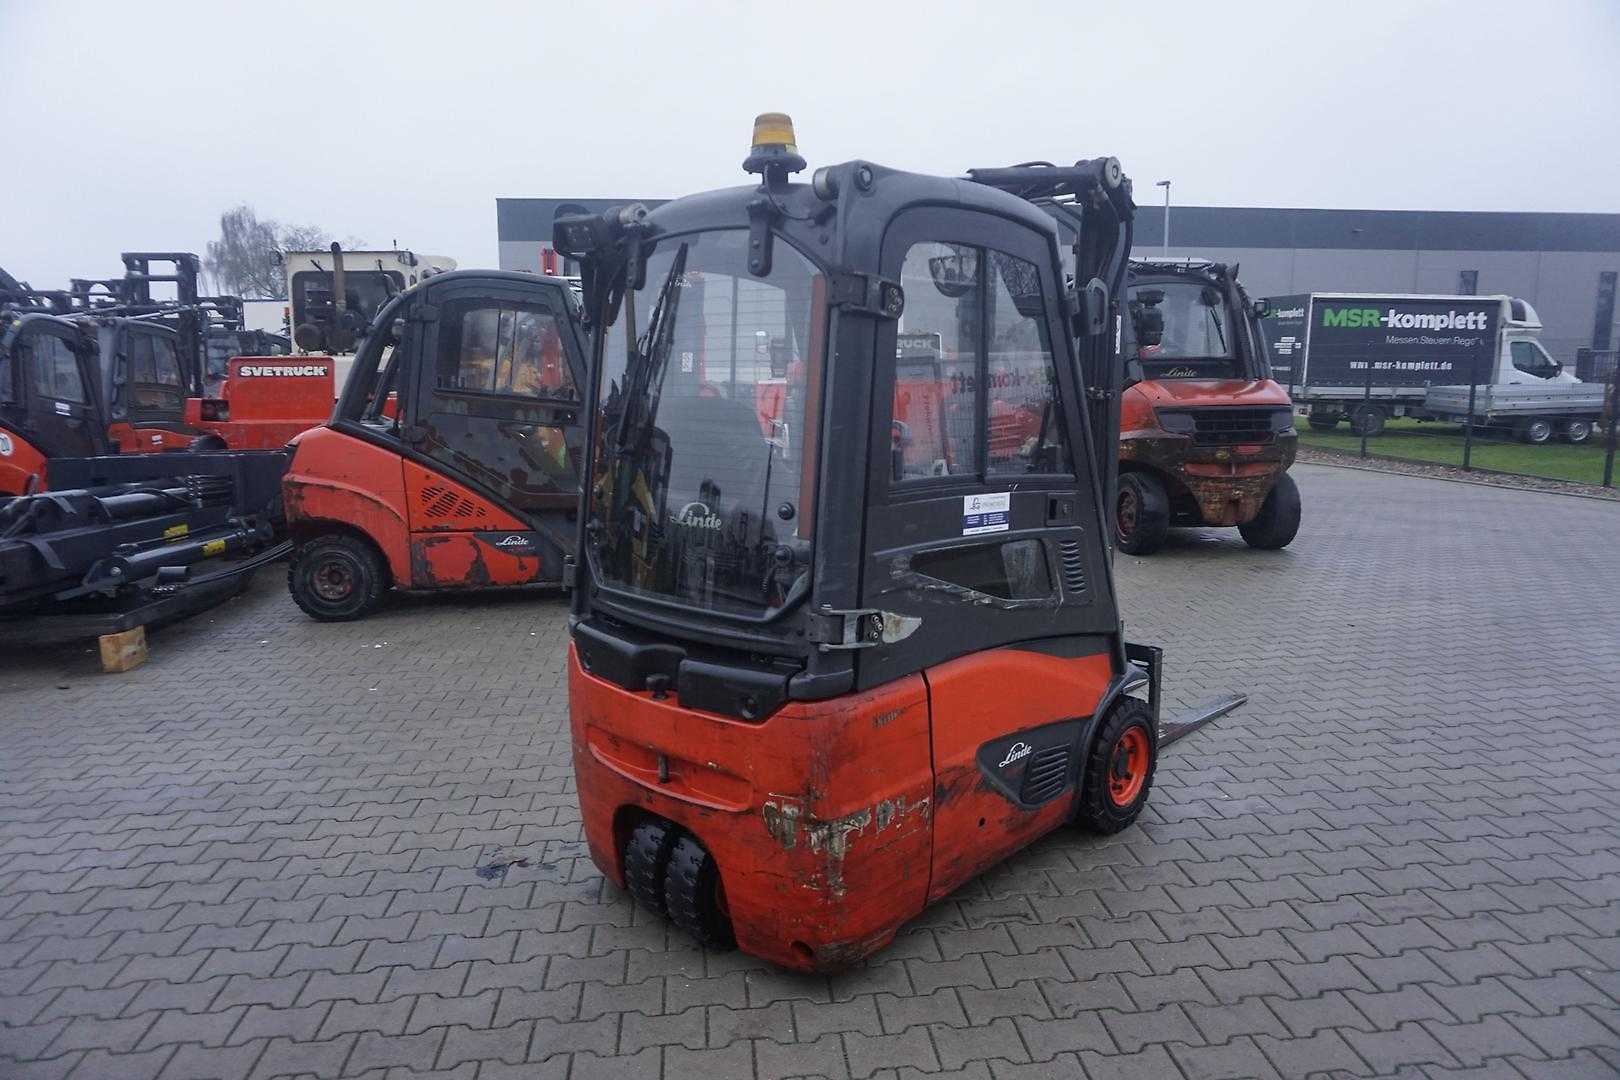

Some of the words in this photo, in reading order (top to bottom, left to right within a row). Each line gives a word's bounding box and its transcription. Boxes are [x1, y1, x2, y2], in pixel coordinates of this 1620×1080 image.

[1322, 308, 1488, 331] MSR-komplett
[239, 365, 326, 377] SVETRUCK
[1159, 366, 1198, 378] Linde
[668, 502, 722, 530] Linde
[495, 535, 529, 547] Linde
[998, 742, 1032, 768] Linde
